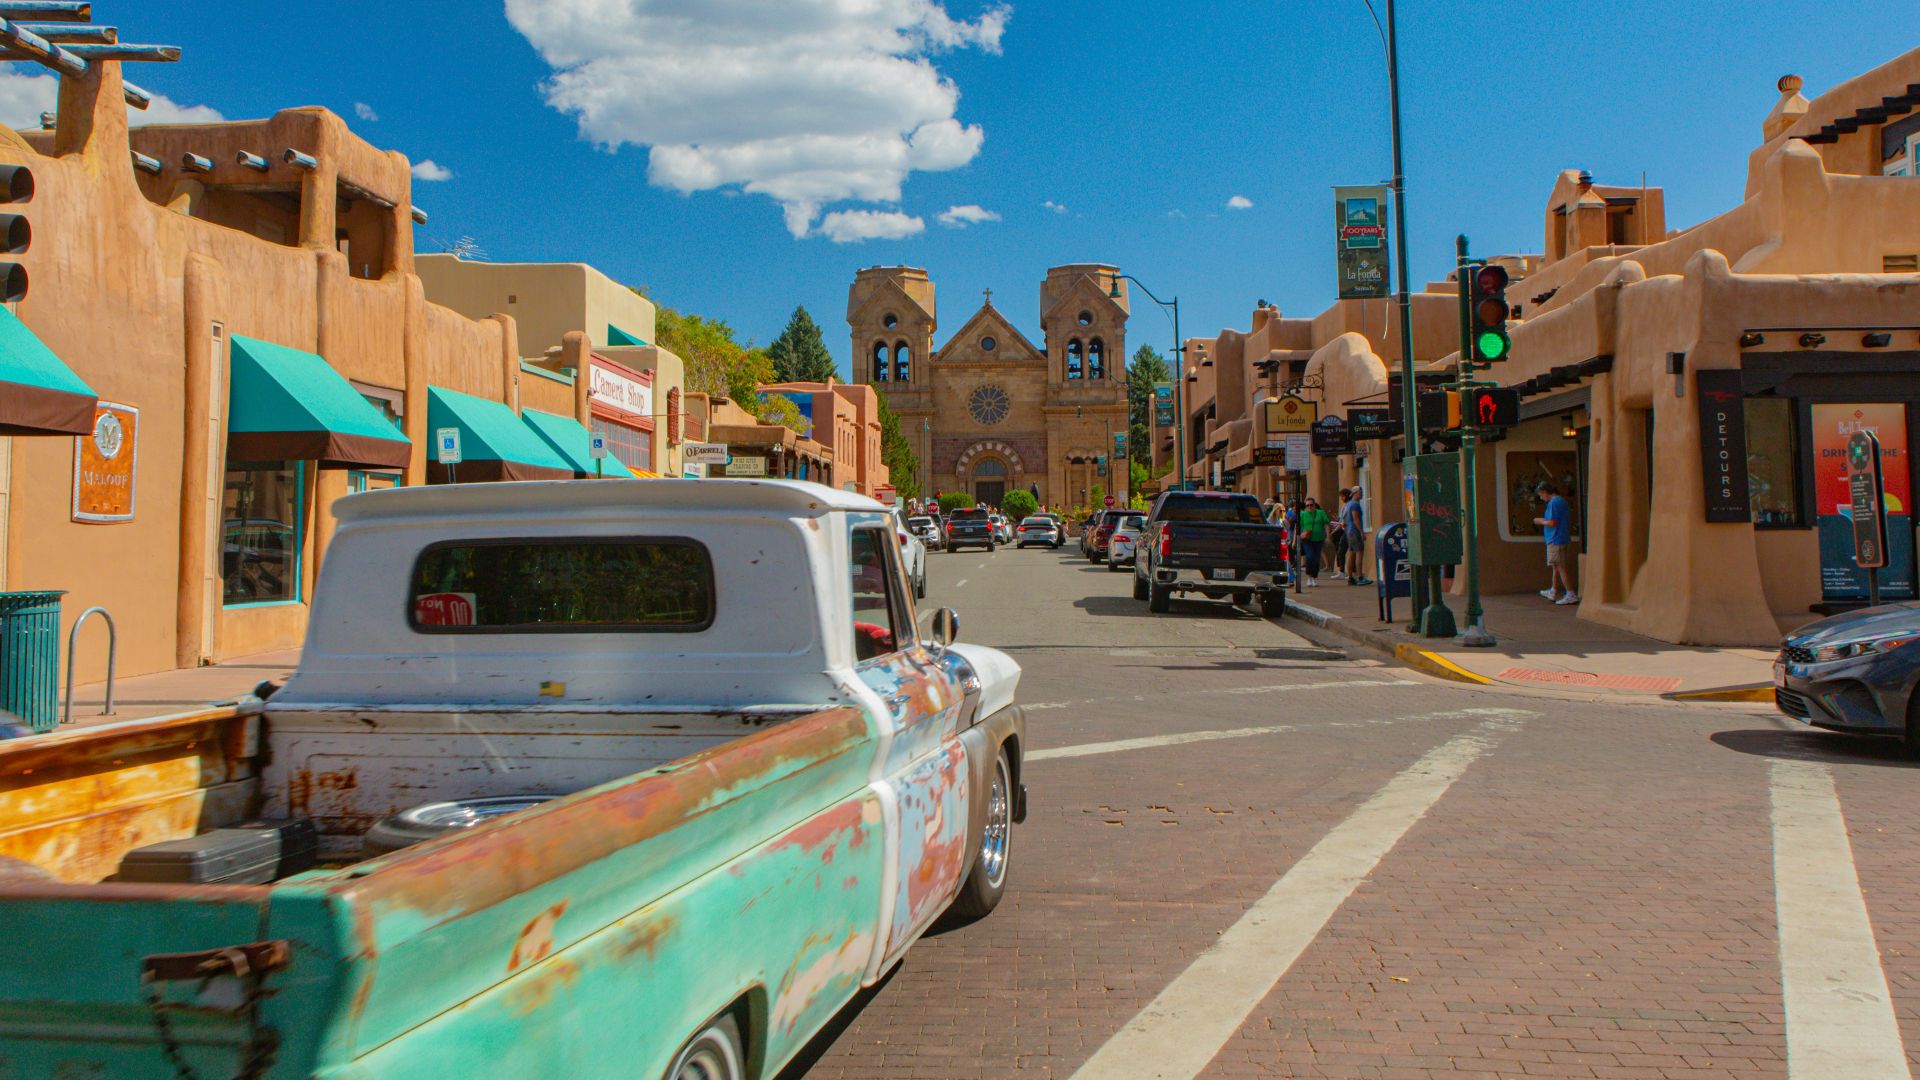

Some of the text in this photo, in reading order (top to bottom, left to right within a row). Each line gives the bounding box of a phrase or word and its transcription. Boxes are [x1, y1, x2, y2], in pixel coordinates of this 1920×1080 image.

[1360, 227, 1378, 235] YEARS
[1347, 267, 1356, 280] La
[594, 368, 645, 415] Camera Shop
[1277, 415, 1285, 425] La
[1838, 420, 1855, 434] Bell
[1717, 412, 1731, 498] DETOURS
